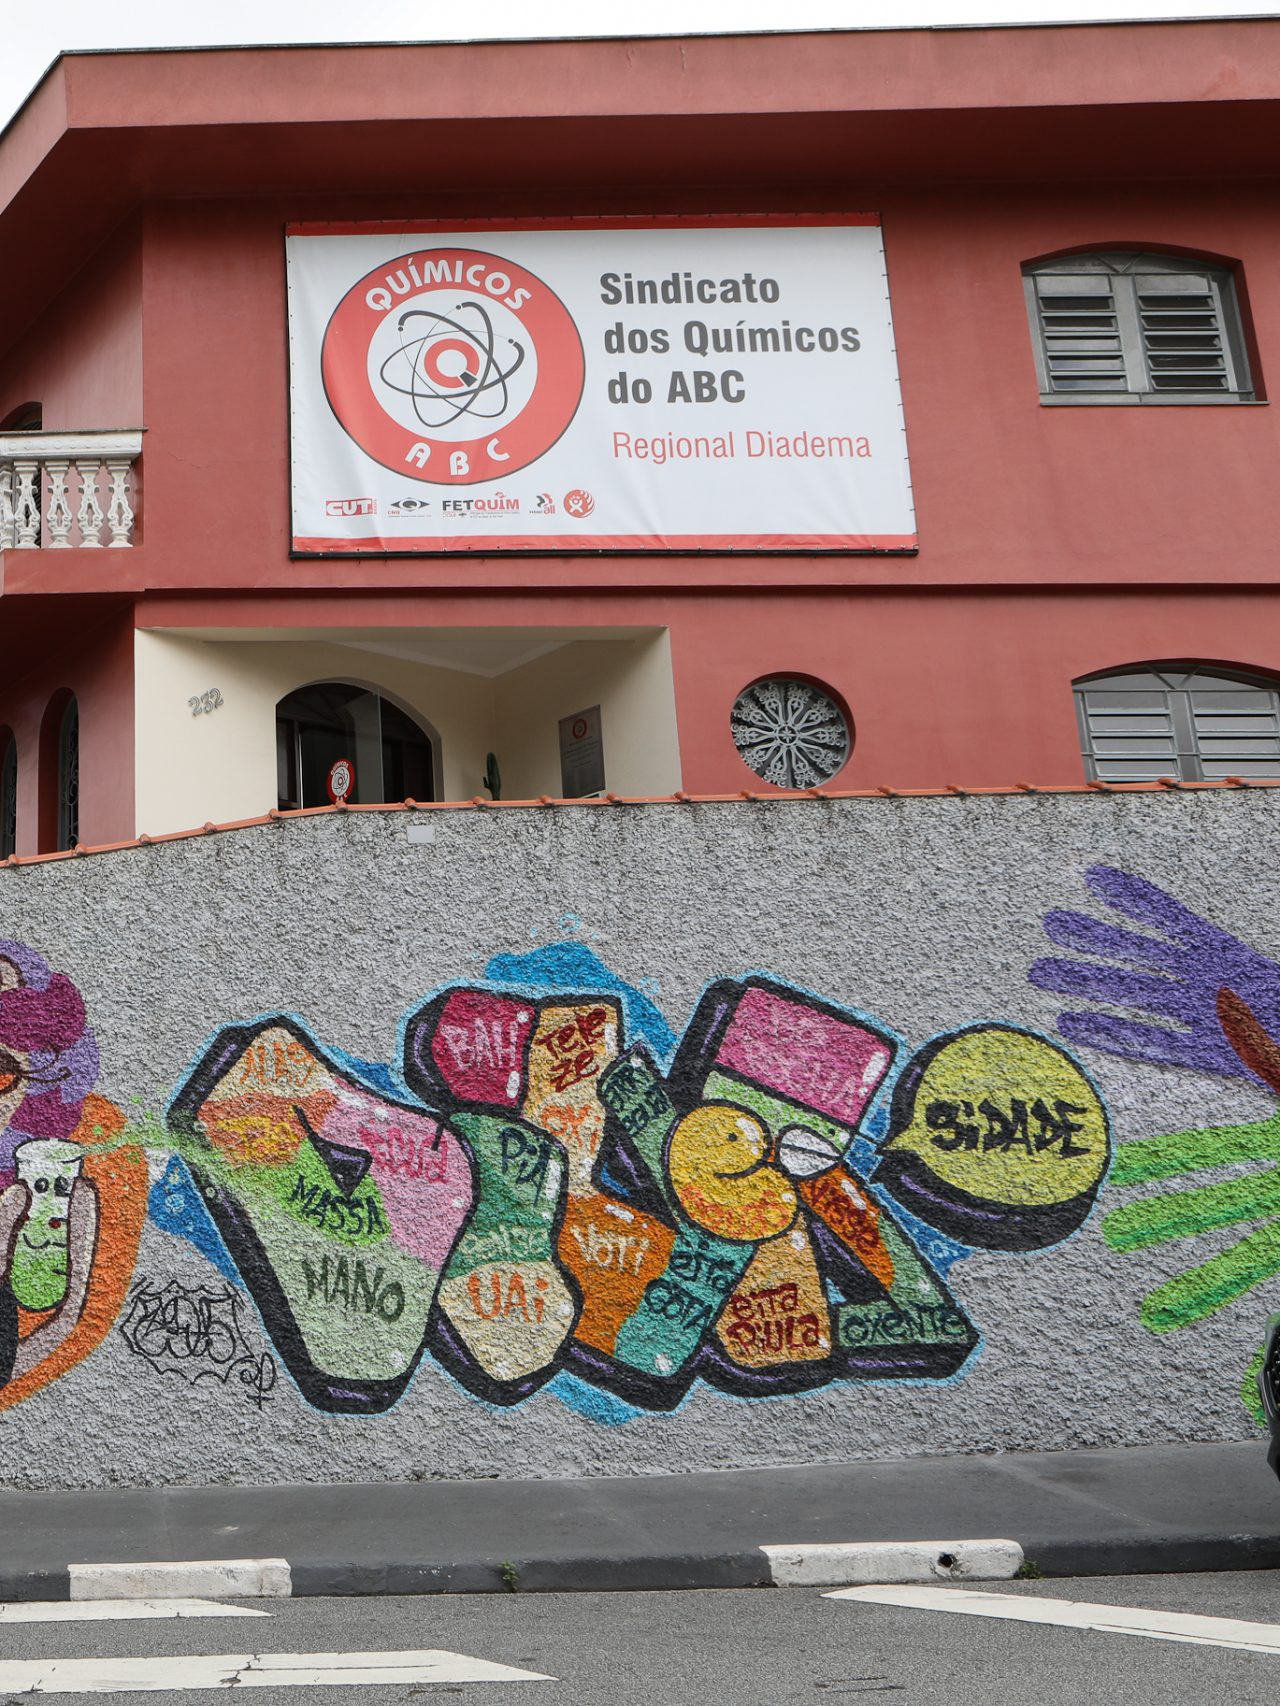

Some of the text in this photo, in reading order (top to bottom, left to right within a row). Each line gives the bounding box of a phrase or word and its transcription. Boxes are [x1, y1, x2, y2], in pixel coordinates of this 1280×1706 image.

[365, 257, 532, 312] QUÍMICOS
[599, 272, 780, 305] Sindicato
[604, 320, 861, 357] dos Químicos
[607, 369, 746, 404] do ABC
[612, 430, 873, 465] Regional Diadema
[325, 499, 372, 515] CUT
[187, 687, 224, 717] 232
[439, 1017, 520, 1072] BAH
[288, 1174, 387, 1235] MASSA
[301, 1252, 405, 1325] MANO
